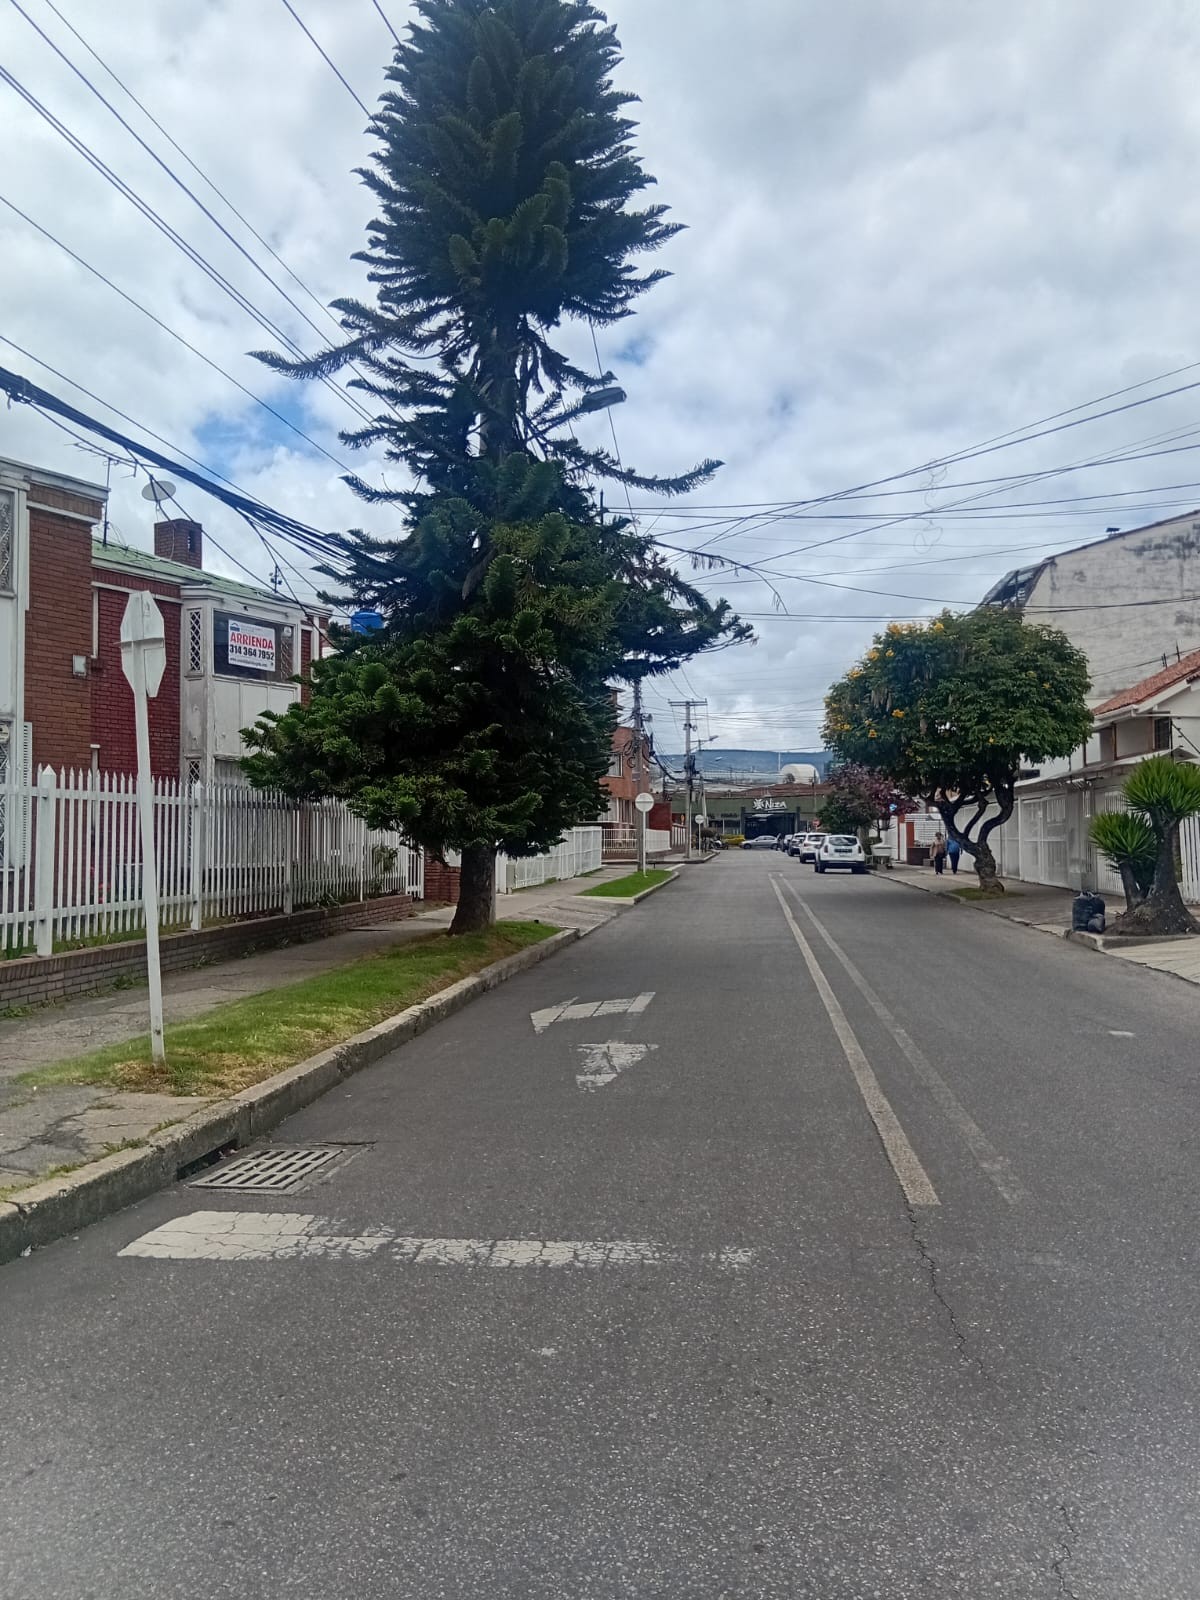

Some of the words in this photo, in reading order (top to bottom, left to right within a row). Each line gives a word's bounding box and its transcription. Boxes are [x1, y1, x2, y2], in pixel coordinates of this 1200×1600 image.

[230, 632, 274, 650] ARRIENDA
[229, 645, 242, 655] 314
[243, 647, 257, 657] 364
